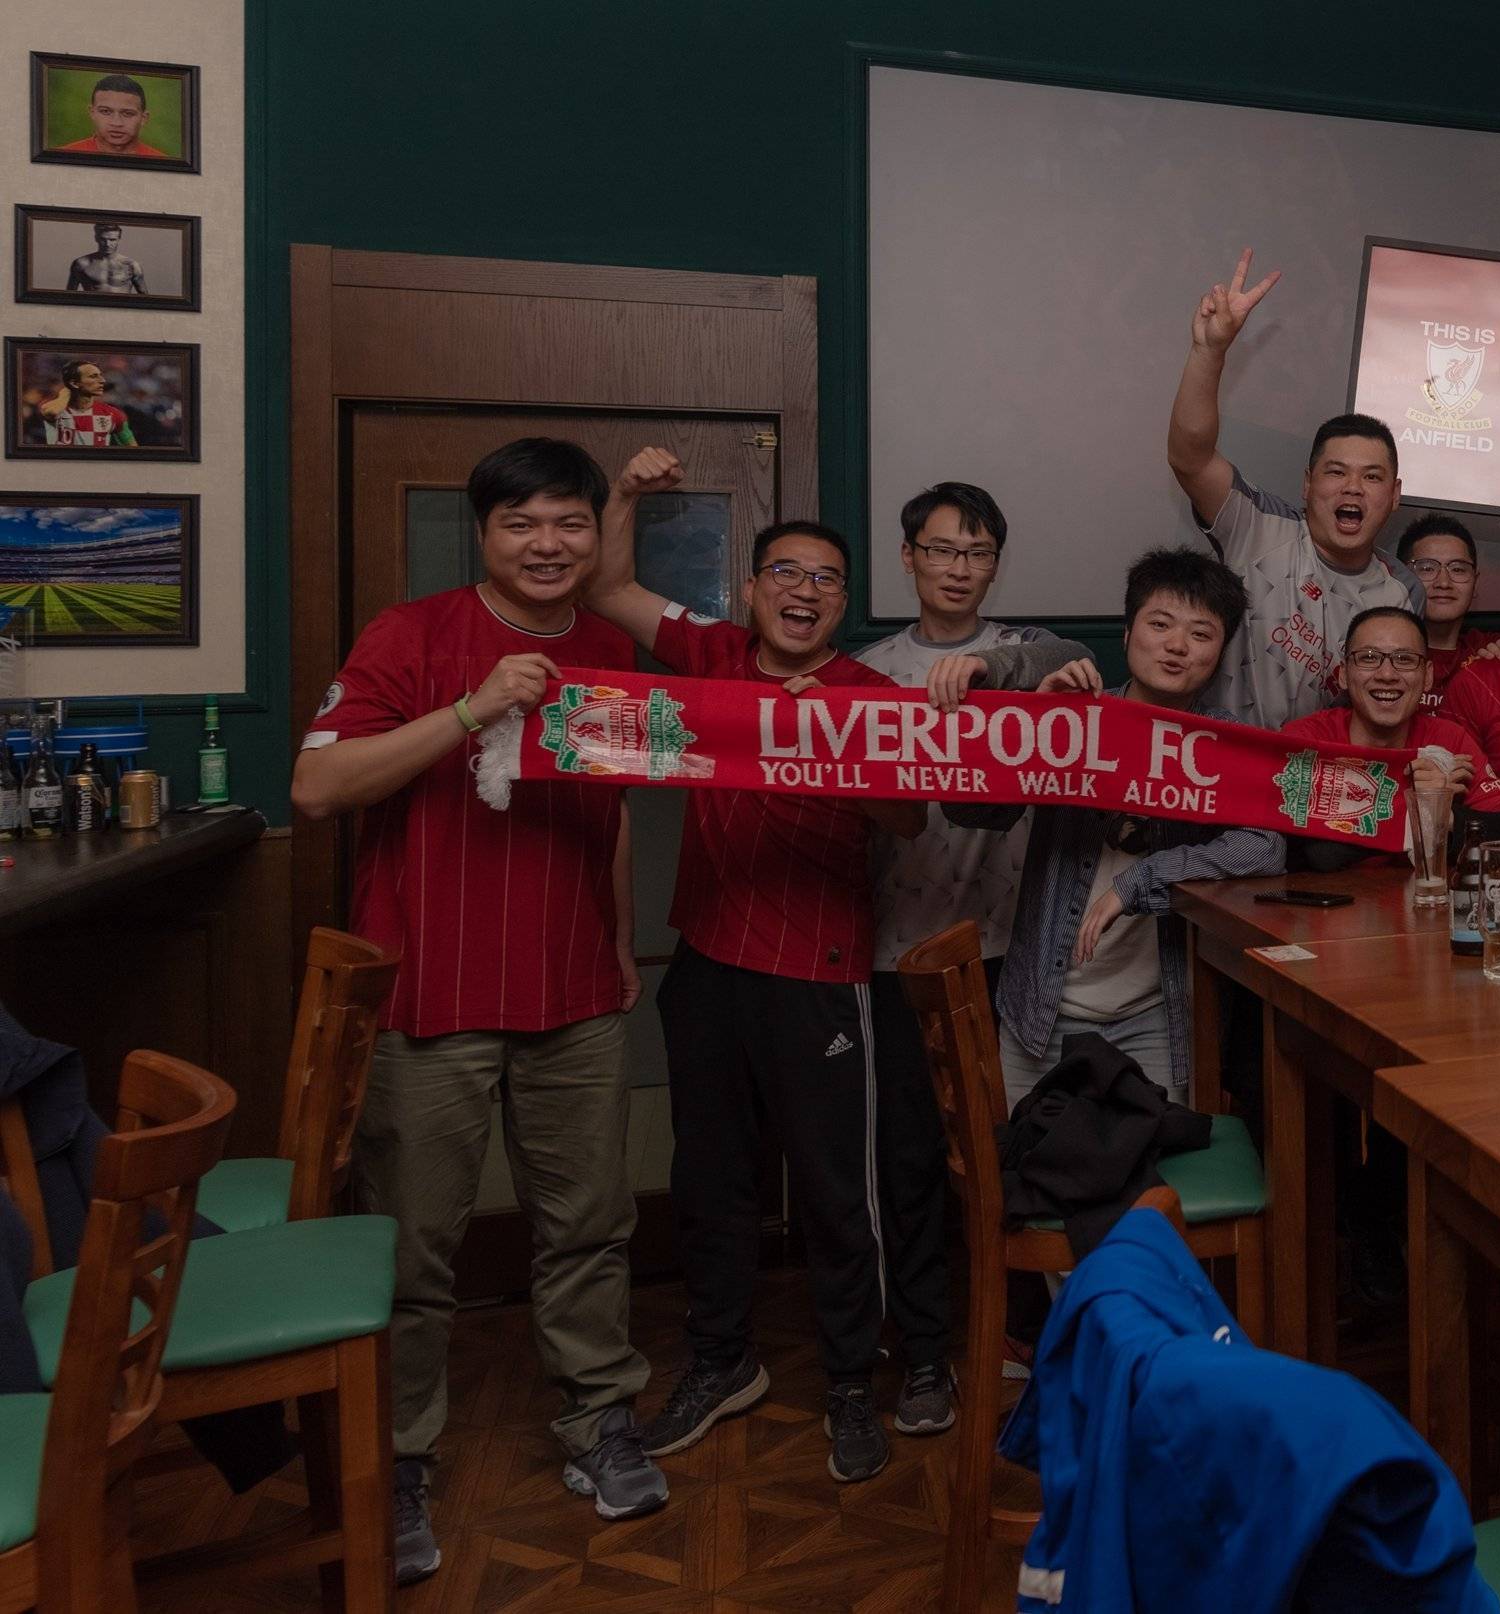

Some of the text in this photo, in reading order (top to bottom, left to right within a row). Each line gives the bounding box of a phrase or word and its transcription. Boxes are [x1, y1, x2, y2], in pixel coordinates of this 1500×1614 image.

[1420, 320, 1496, 345] THIS IS
[1399, 427, 1494, 453] ANFIELD
[1409, 409, 1461, 430] FOOTBALL
[758, 697, 1221, 787] LIVERPOOL FC
[77, 785, 93, 831] Watson's
[758, 760, 1217, 815] YOU'LL NEVER WALK ALONE
[1318, 764, 1335, 814] LIVERPOOL
